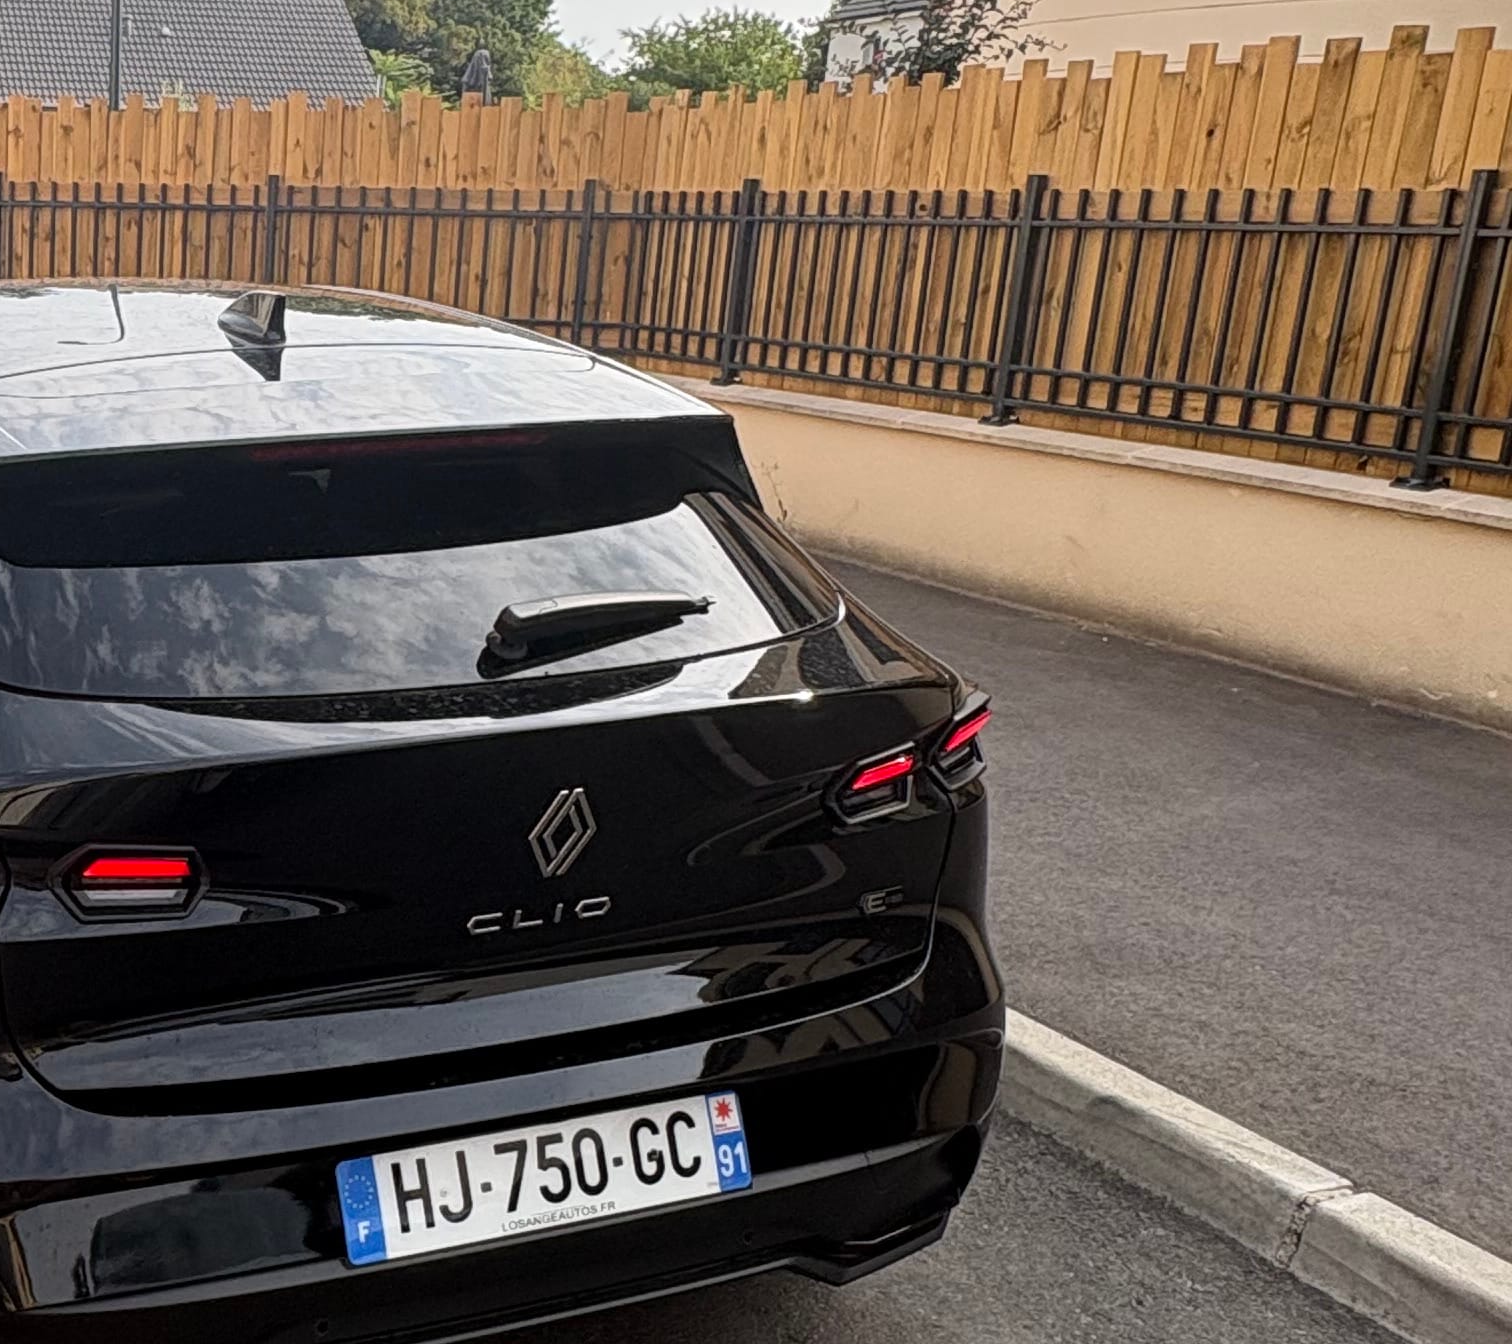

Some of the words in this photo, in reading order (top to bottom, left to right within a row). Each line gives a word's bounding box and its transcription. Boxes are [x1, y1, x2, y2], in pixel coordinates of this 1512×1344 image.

[466, 896, 611, 935] CLIO
[391, 1110, 702, 1234] HJ-750-GC
[718, 1141, 748, 1178] 91
[357, 1221, 372, 1244] F
